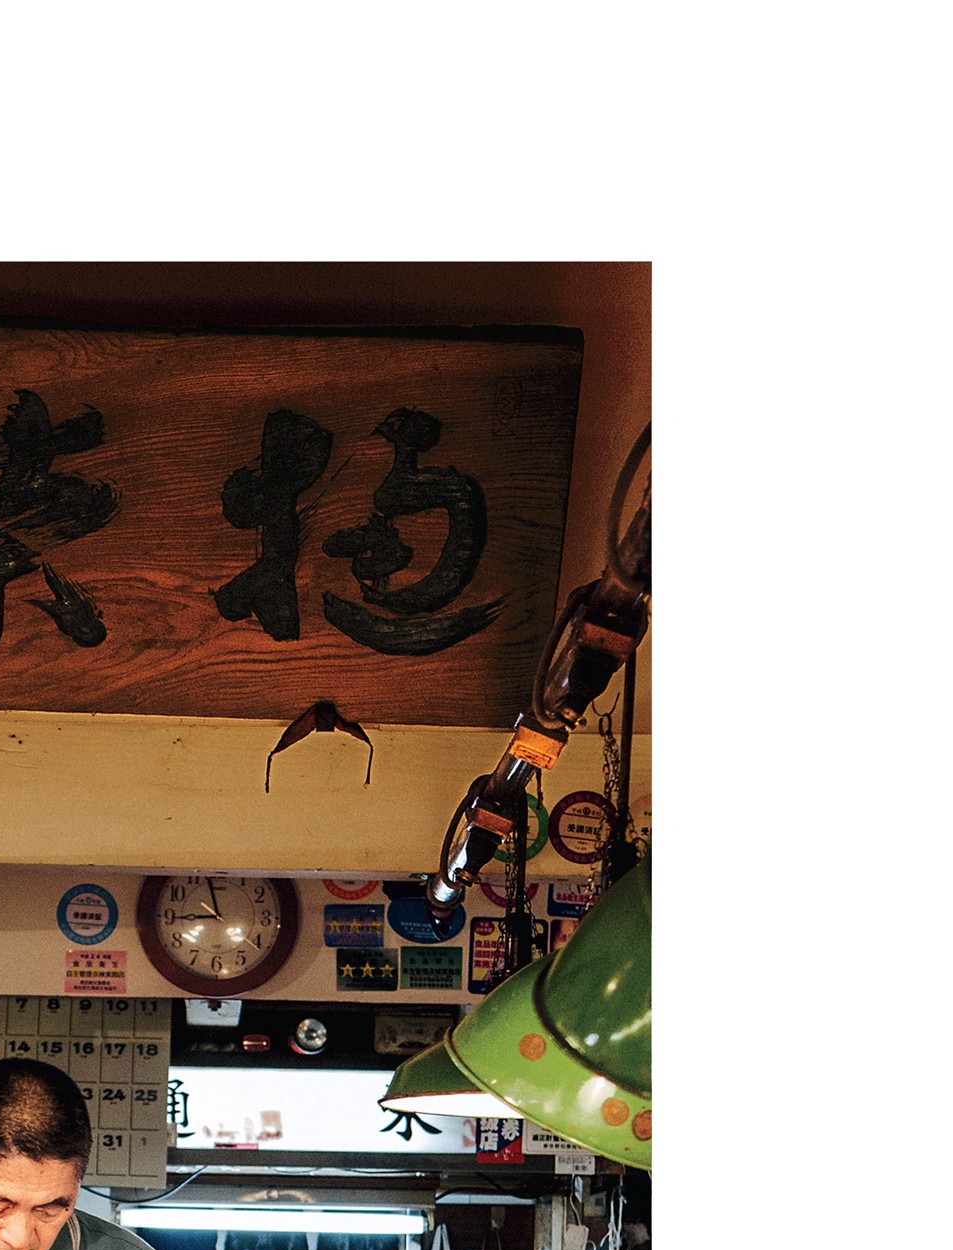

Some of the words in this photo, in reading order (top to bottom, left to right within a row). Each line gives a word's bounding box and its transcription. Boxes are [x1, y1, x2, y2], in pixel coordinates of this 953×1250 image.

[170, 886, 185, 902] 10
[254, 886, 265, 903] 2
[164, 909, 176, 924] 9
[260, 910, 271, 926] 3
[172, 932, 182, 949] 8
[189, 949, 200, 966] 7
[211, 955, 222, 972] 6
[235, 950, 247, 966] 5
[16, 997, 29, 1009] 7
[47, 998, 60, 1011] 8
[79, 999, 92, 1011] 9
[106, 999, 129, 1012] 10
[140, 1000, 158, 1013] 11
[9, 1041, 31, 1053] 14
[41, 1042, 63, 1054] 15
[73, 1042, 95, 1055] 16
[104, 1043, 127, 1055] 17
[136, 1044, 159, 1056] 18
[102, 1089, 126, 1102] 24
[135, 1089, 158, 1102] 25
[103, 1135, 123, 1147] 31
